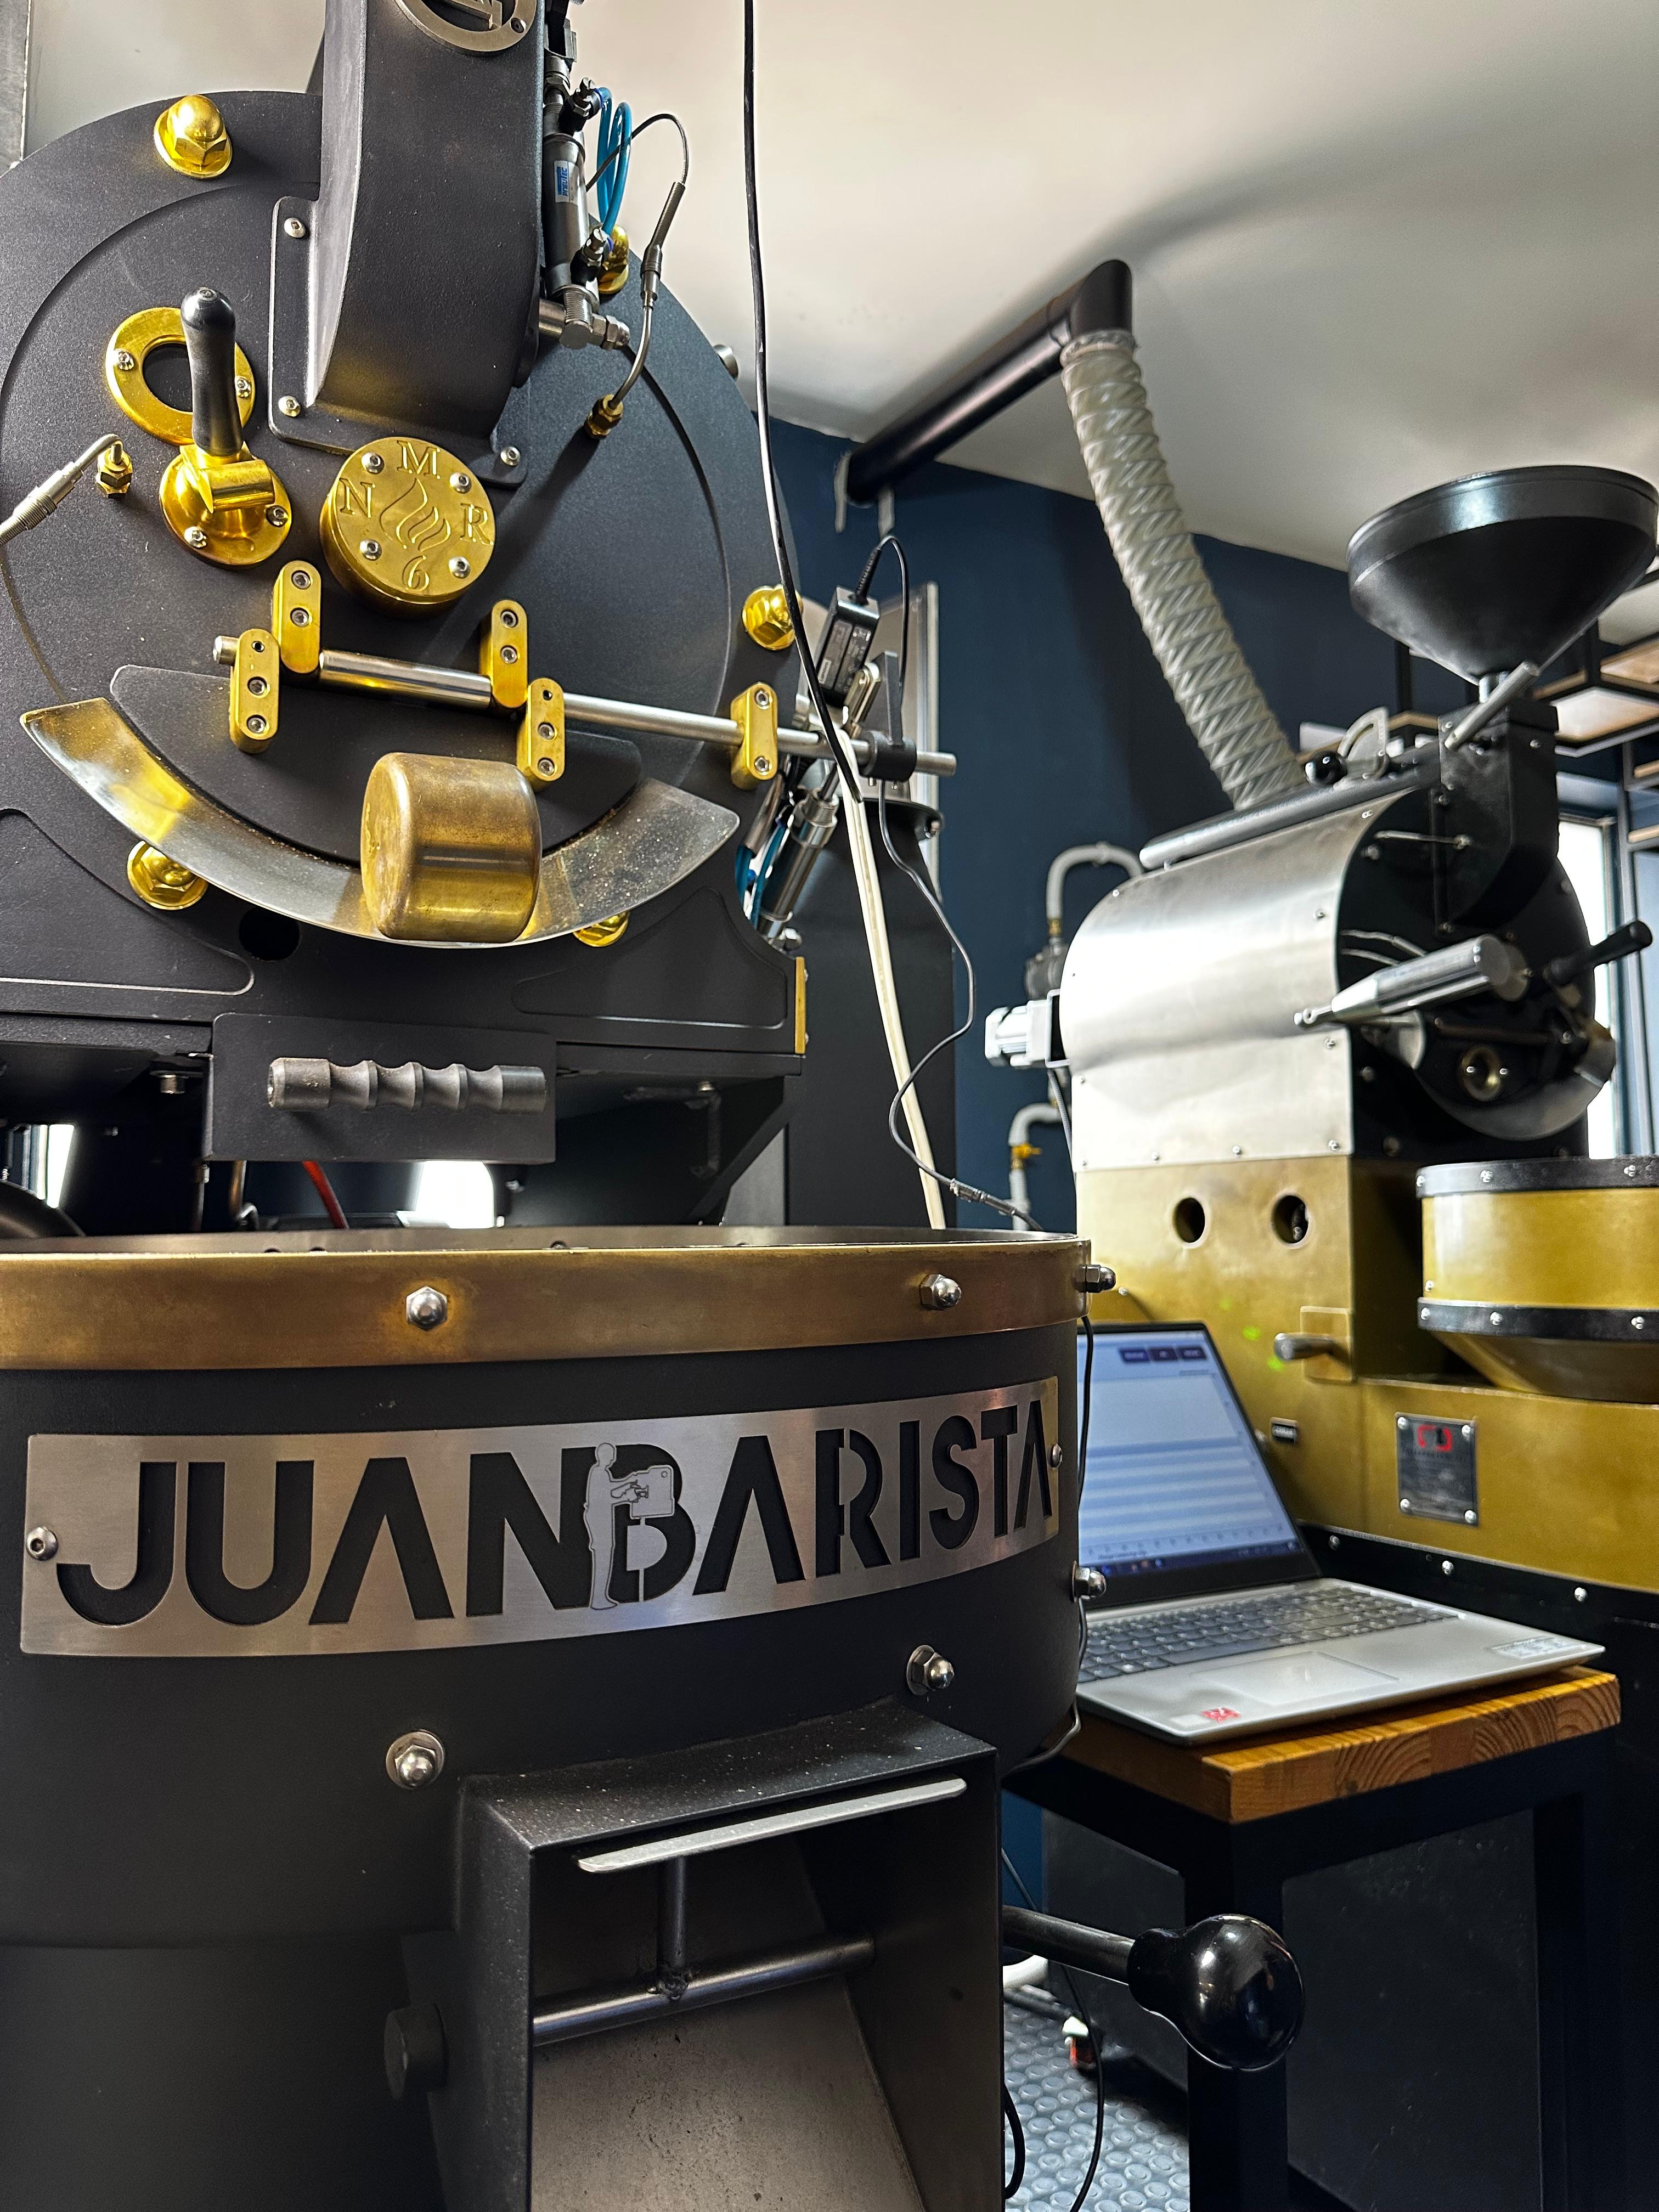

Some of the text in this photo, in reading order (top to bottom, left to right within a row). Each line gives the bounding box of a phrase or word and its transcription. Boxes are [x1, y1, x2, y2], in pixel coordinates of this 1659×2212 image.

[396, 439, 441, 479] M
[338, 477, 376, 518] N
[460, 503, 494, 545] R
[402, 555, 430, 591] 6
